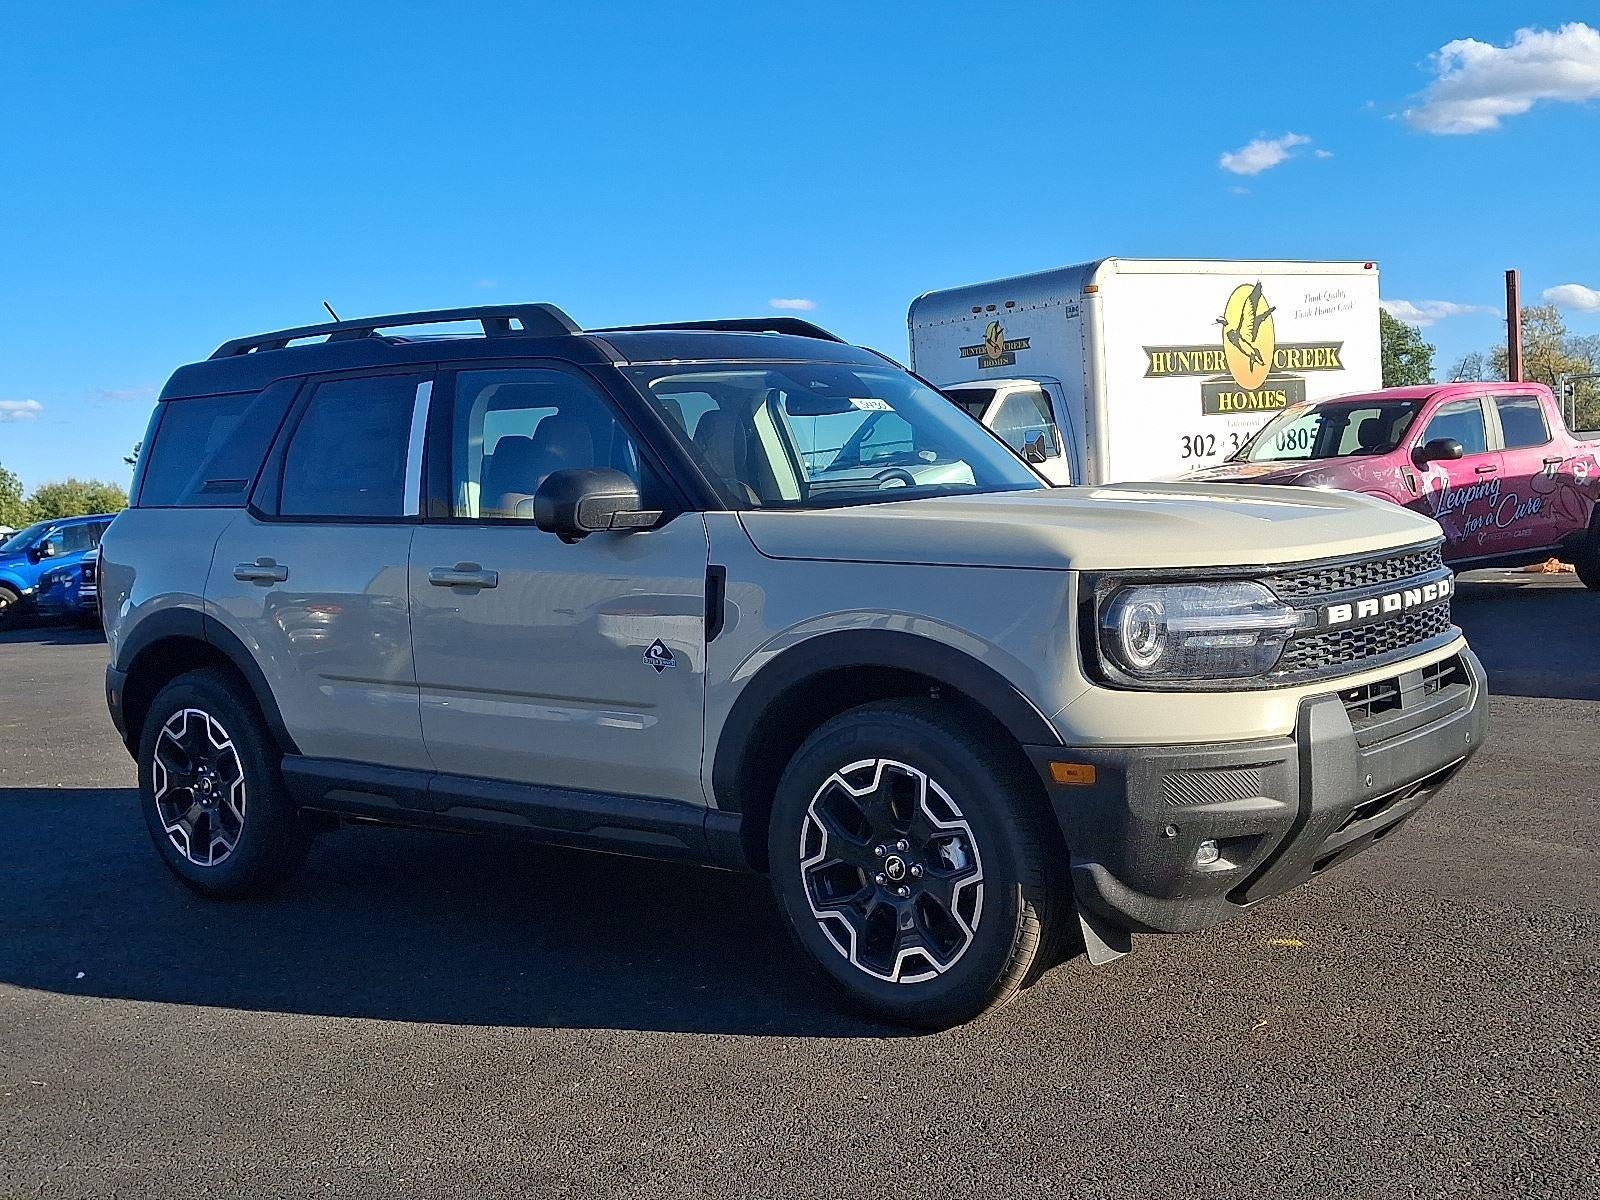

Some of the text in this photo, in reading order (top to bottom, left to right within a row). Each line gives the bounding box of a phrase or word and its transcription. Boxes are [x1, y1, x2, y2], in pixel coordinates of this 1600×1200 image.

[962, 340, 1029, 357] HUNTER CREEK
[1151, 347, 1338, 373] HUNTER CREEK
[983, 357, 1010, 368] HOMES
[1218, 390, 1287, 411] HOMES
[1181, 433, 1217, 459] 302
[1433, 476, 1501, 519] Leaping
[1461, 515, 1484, 542] for
[1485, 513, 1495, 527] a
[1495, 493, 1543, 528] Cure
[1327, 579, 1450, 625] BRONCO
